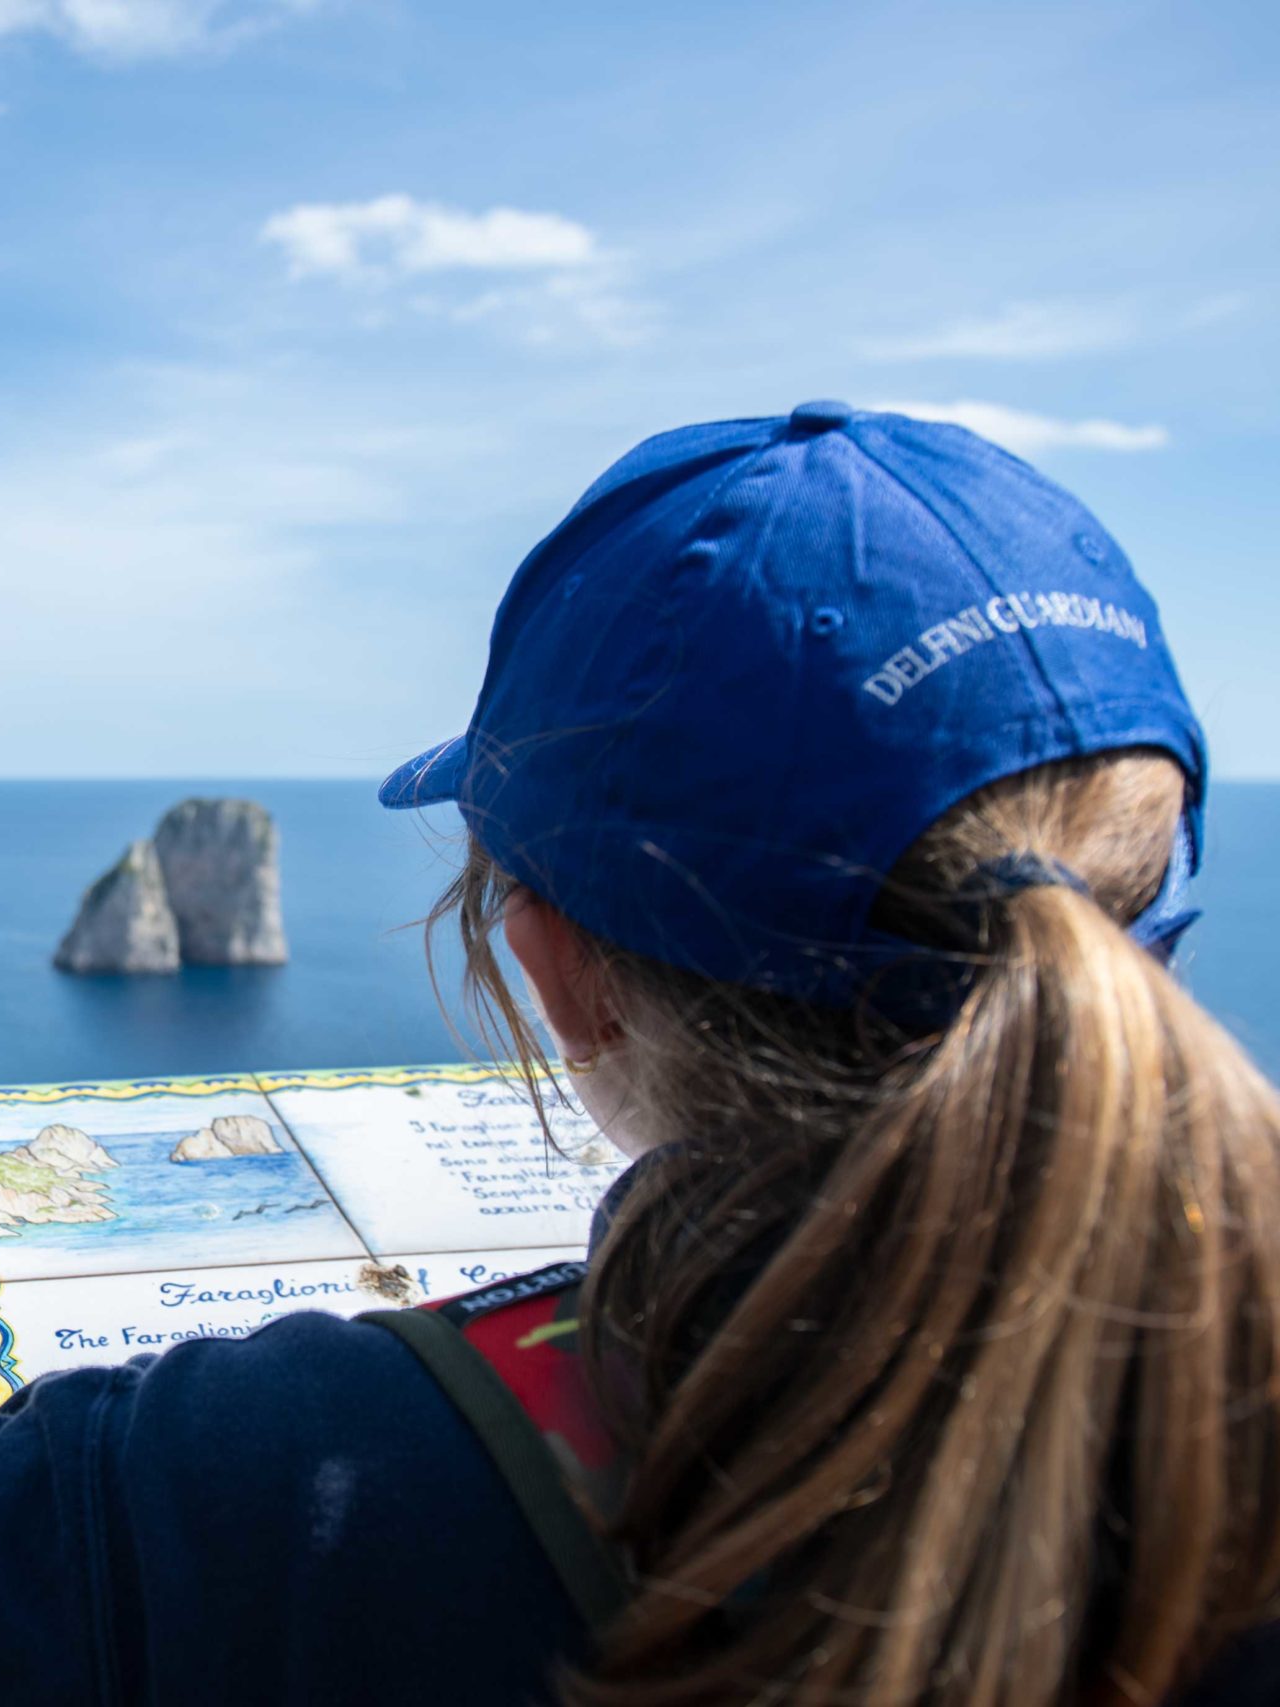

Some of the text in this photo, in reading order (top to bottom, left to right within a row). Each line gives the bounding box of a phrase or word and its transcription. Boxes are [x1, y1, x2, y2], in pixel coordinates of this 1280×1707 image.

[862, 591, 1148, 706] DELFINI GUARDIANI
[160, 1274, 355, 1307] Faraglioni
[460, 1261, 591, 1313] URTON
[55, 1329, 109, 1350] The
